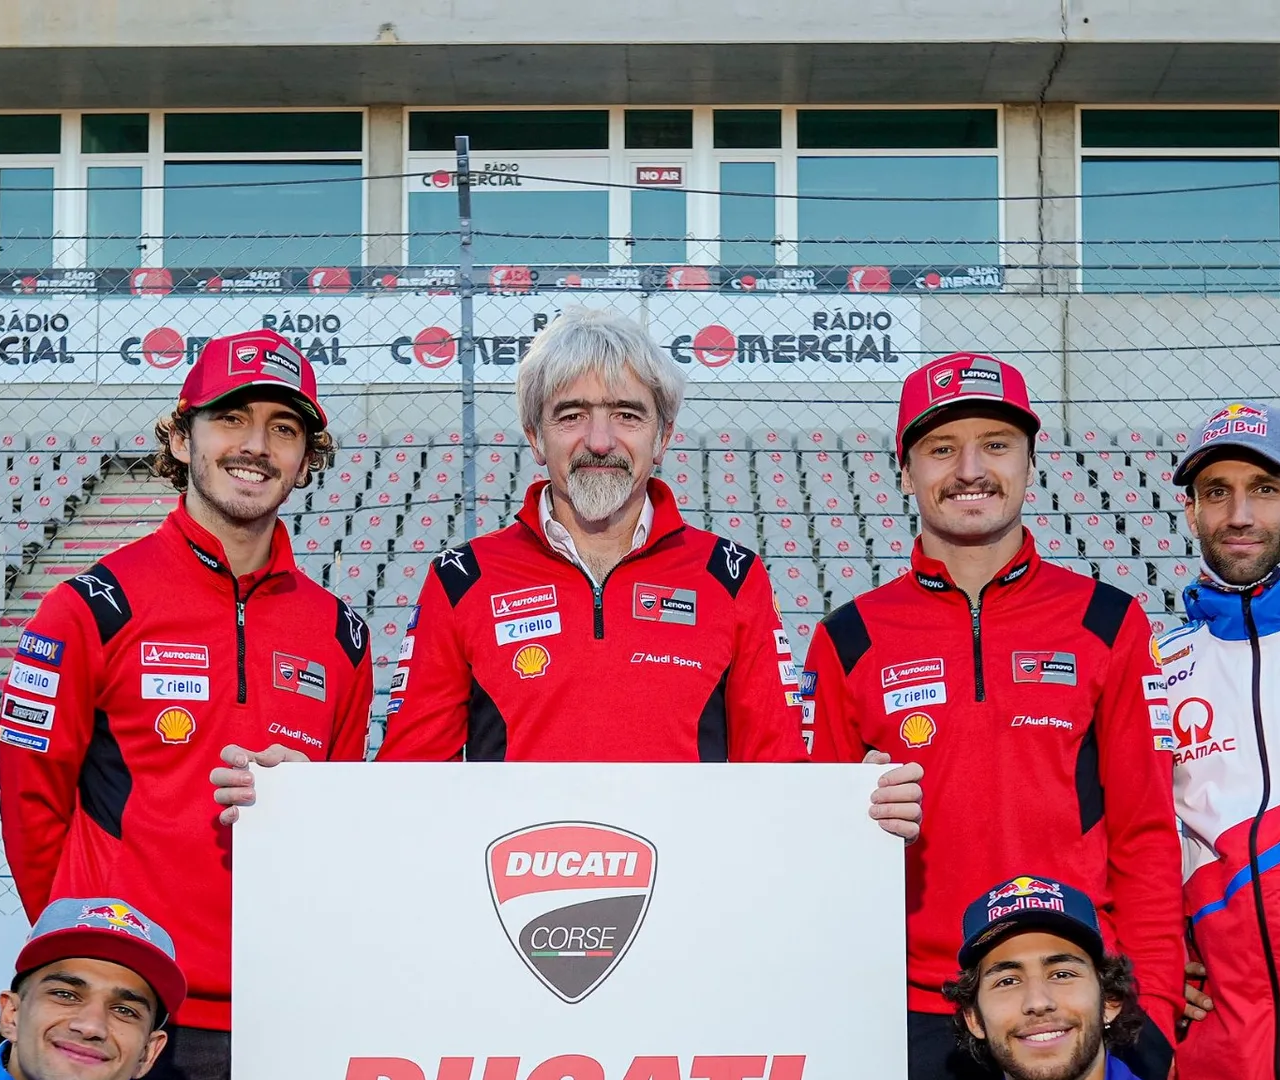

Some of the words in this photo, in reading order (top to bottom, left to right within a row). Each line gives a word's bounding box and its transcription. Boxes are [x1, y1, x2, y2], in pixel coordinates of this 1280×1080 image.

[484, 161, 519, 173] RÁDIO
[639, 170, 658, 181] NO
[660, 170, 679, 181] AR
[263, 309, 341, 333] RÁDIO
[812, 309, 891, 331] RÁDIO
[671, 324, 900, 369] COMERCIAL
[265, 350, 298, 373] Lenovo
[961, 369, 998, 380] Lenovo
[1202, 421, 1231, 445] Red
[1233, 420, 1267, 437] Bull
[918, 575, 944, 588] Lenovo
[511, 593, 554, 607] AUTOGRILL
[663, 599, 692, 610] Lenovo
[519, 619, 553, 634] riello
[162, 651, 206, 662] AUTOGRILL
[645, 654, 671, 664] Audi
[672, 656, 702, 670] Sport
[899, 664, 941, 677] AUTOGRILL
[1043, 662, 1073, 672] Lenovo
[20, 670, 49, 688] riello
[299, 671, 323, 686] Lenovo
[167, 680, 202, 694] riello
[903, 688, 937, 704] riello
[1024, 716, 1049, 726] Audi
[1049, 717, 1073, 731] Sport
[279, 726, 302, 741] Audi
[302, 731, 323, 749] Sport
[505, 850, 639, 878] DUCATI
[988, 898, 1024, 923] Red
[1026, 897, 1065, 913] Bull
[530, 926, 617, 951] CORSE
